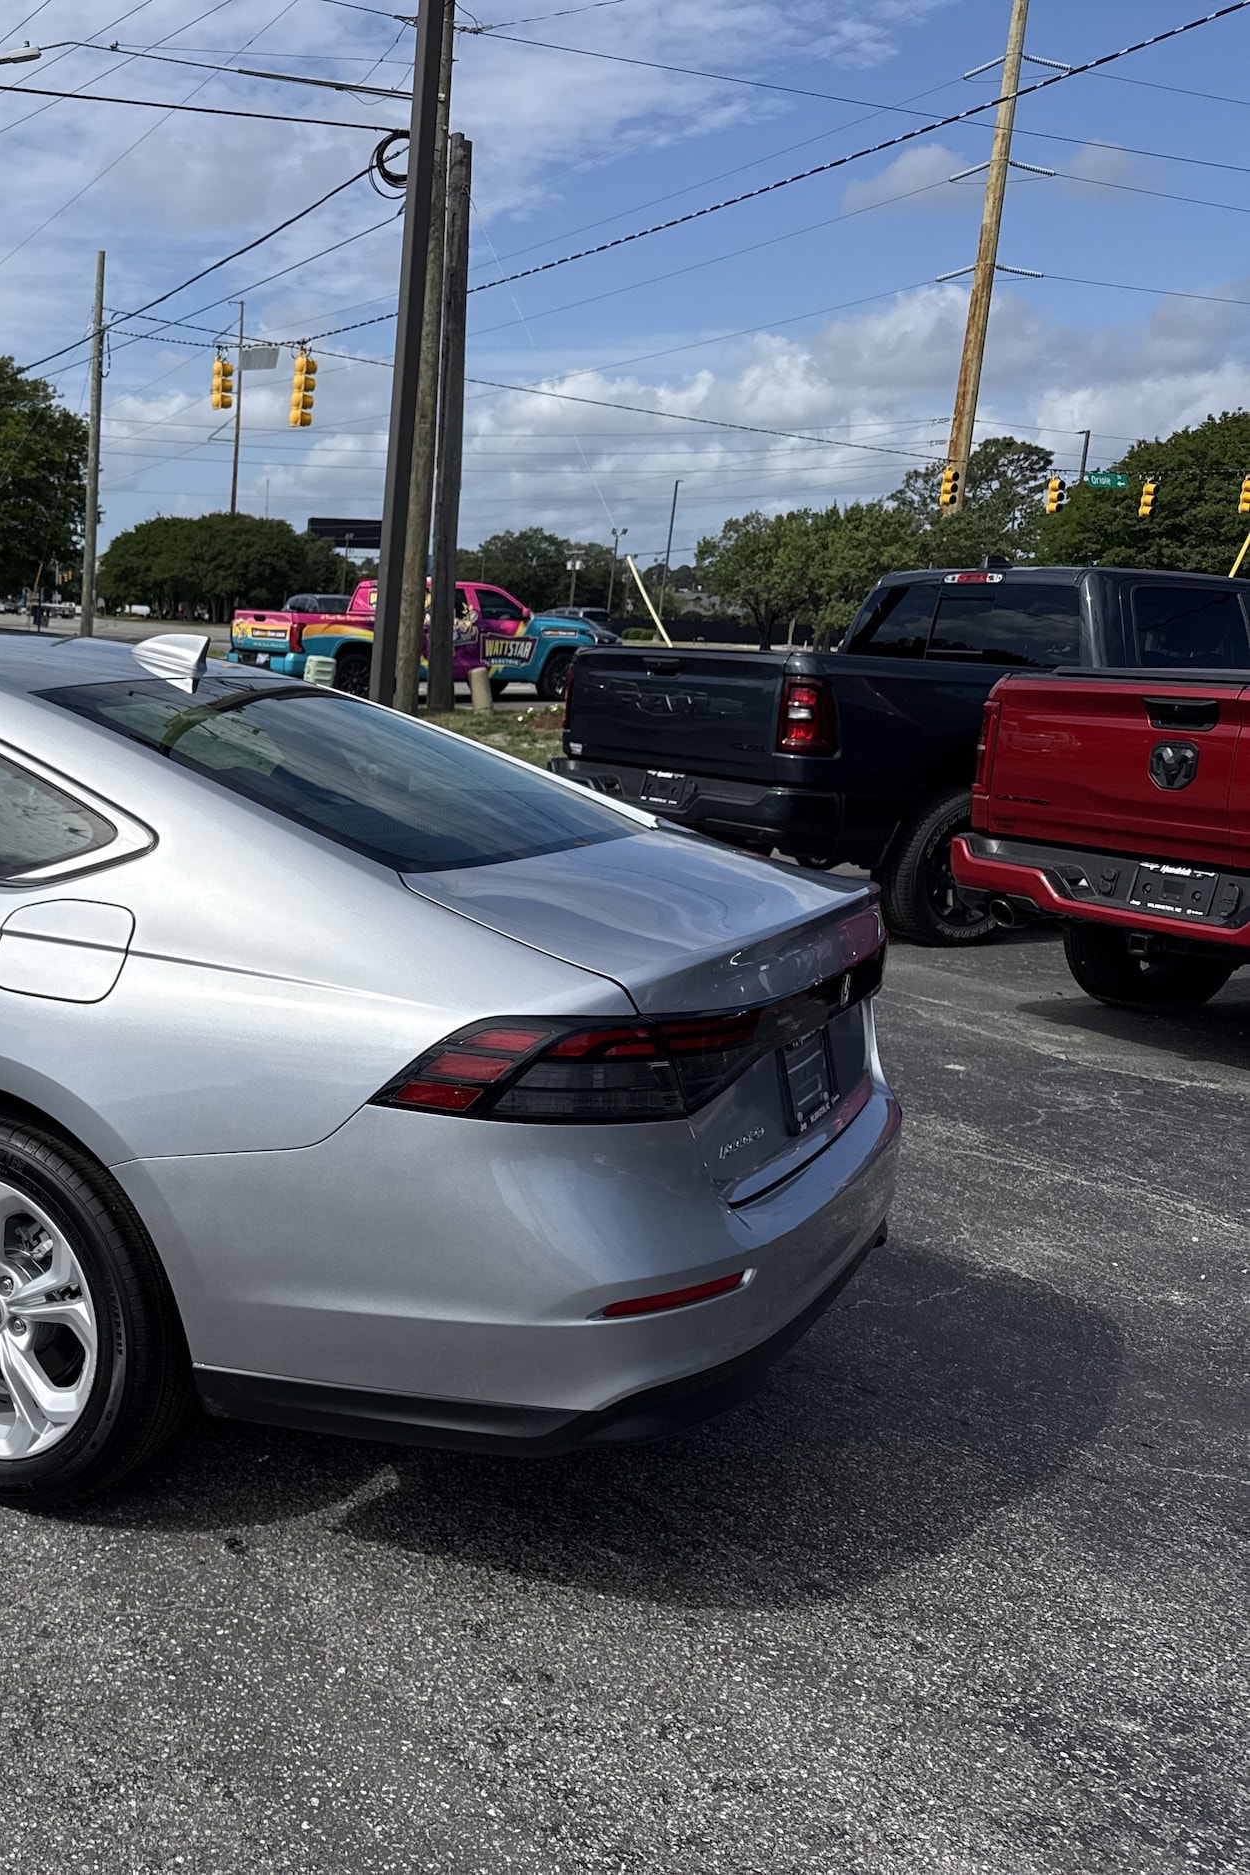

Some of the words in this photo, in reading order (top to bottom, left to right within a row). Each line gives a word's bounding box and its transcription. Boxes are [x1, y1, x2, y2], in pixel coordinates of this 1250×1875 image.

[1091, 475, 1111, 486] Oriole
[485, 640, 532, 659] WATTSTAR
[994, 793, 1052, 807] LIMITED
[1159, 864, 1192, 876] Hendrick
